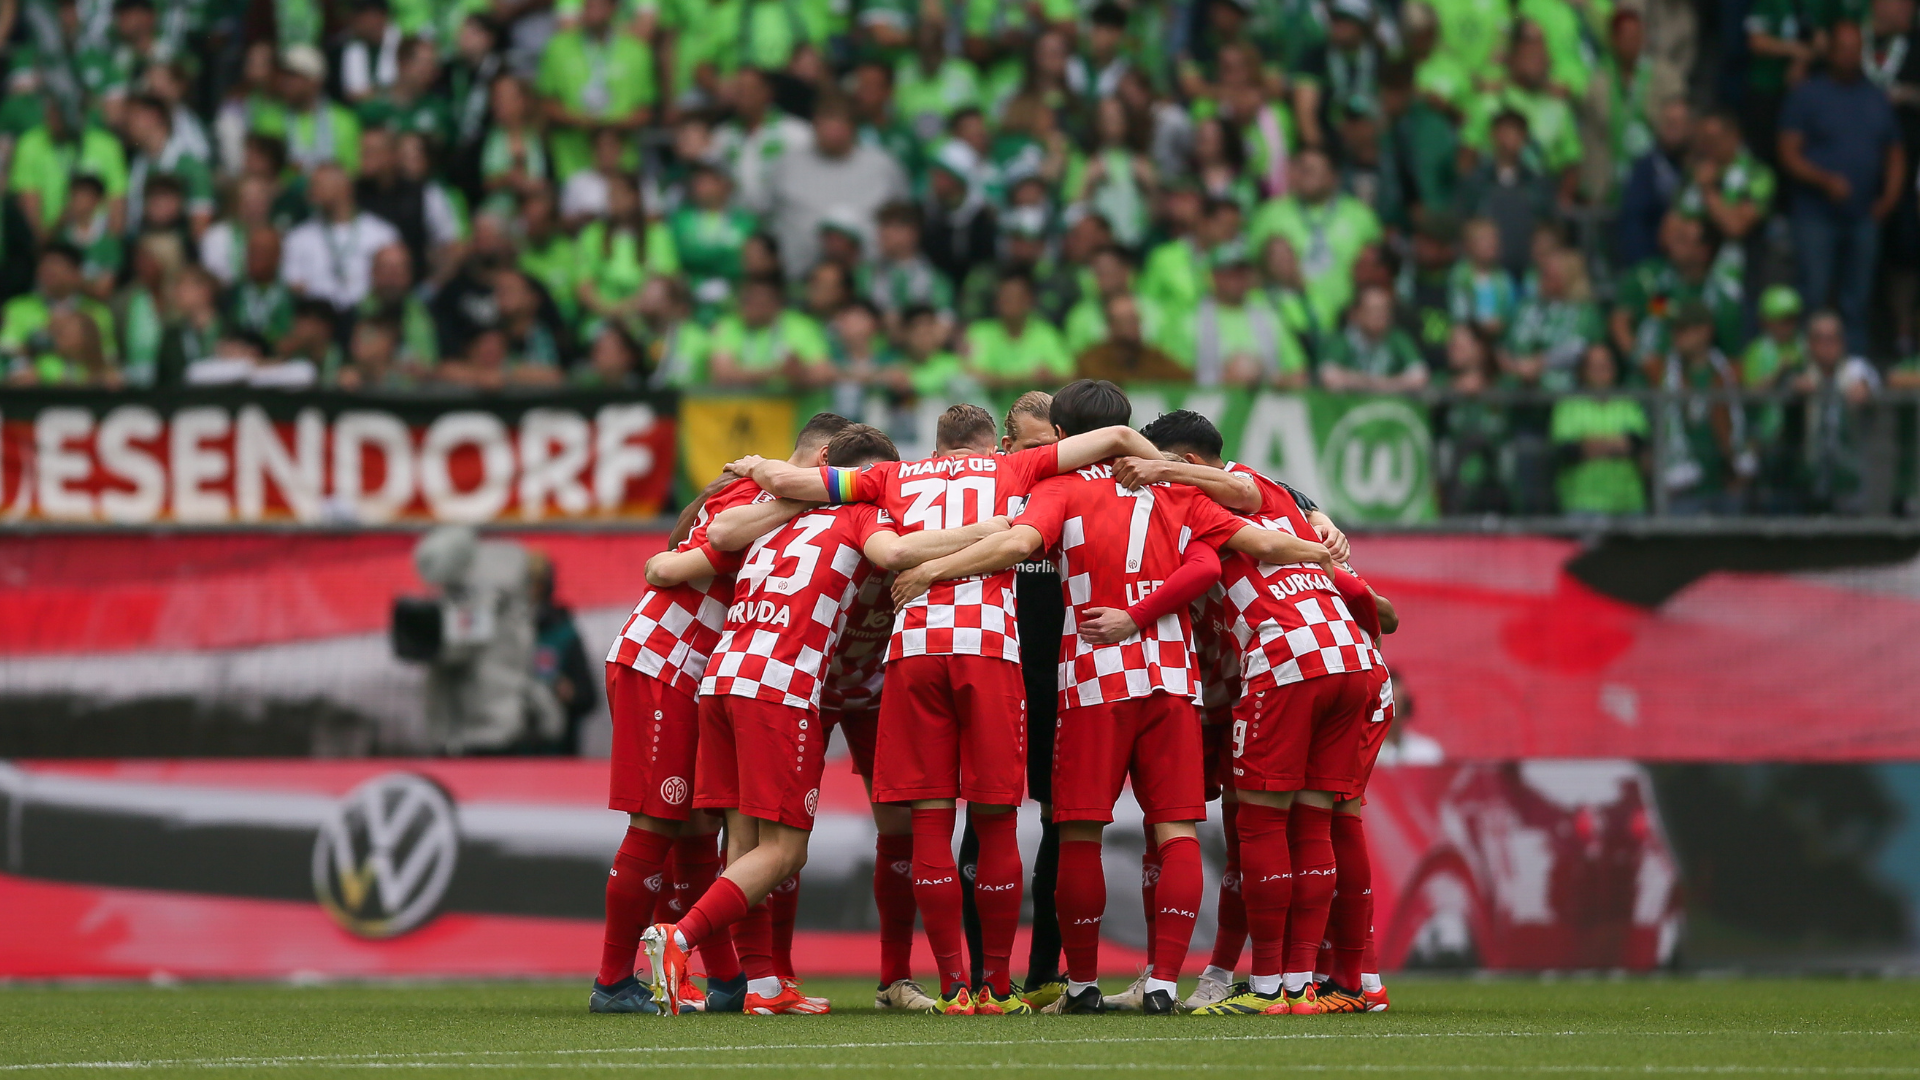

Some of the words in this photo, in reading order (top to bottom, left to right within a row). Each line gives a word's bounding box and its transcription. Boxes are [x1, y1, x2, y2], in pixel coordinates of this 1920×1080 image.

[898, 457, 966, 478] MAINZ
[968, 458, 997, 471] 05
[900, 475, 996, 530] 30
[1115, 482, 1155, 574] 7
[736, 513, 837, 597] 43
[915, 876, 953, 885] JAKO
[977, 883, 1015, 892] JAKO
[1160, 907, 1195, 919] JAKO
